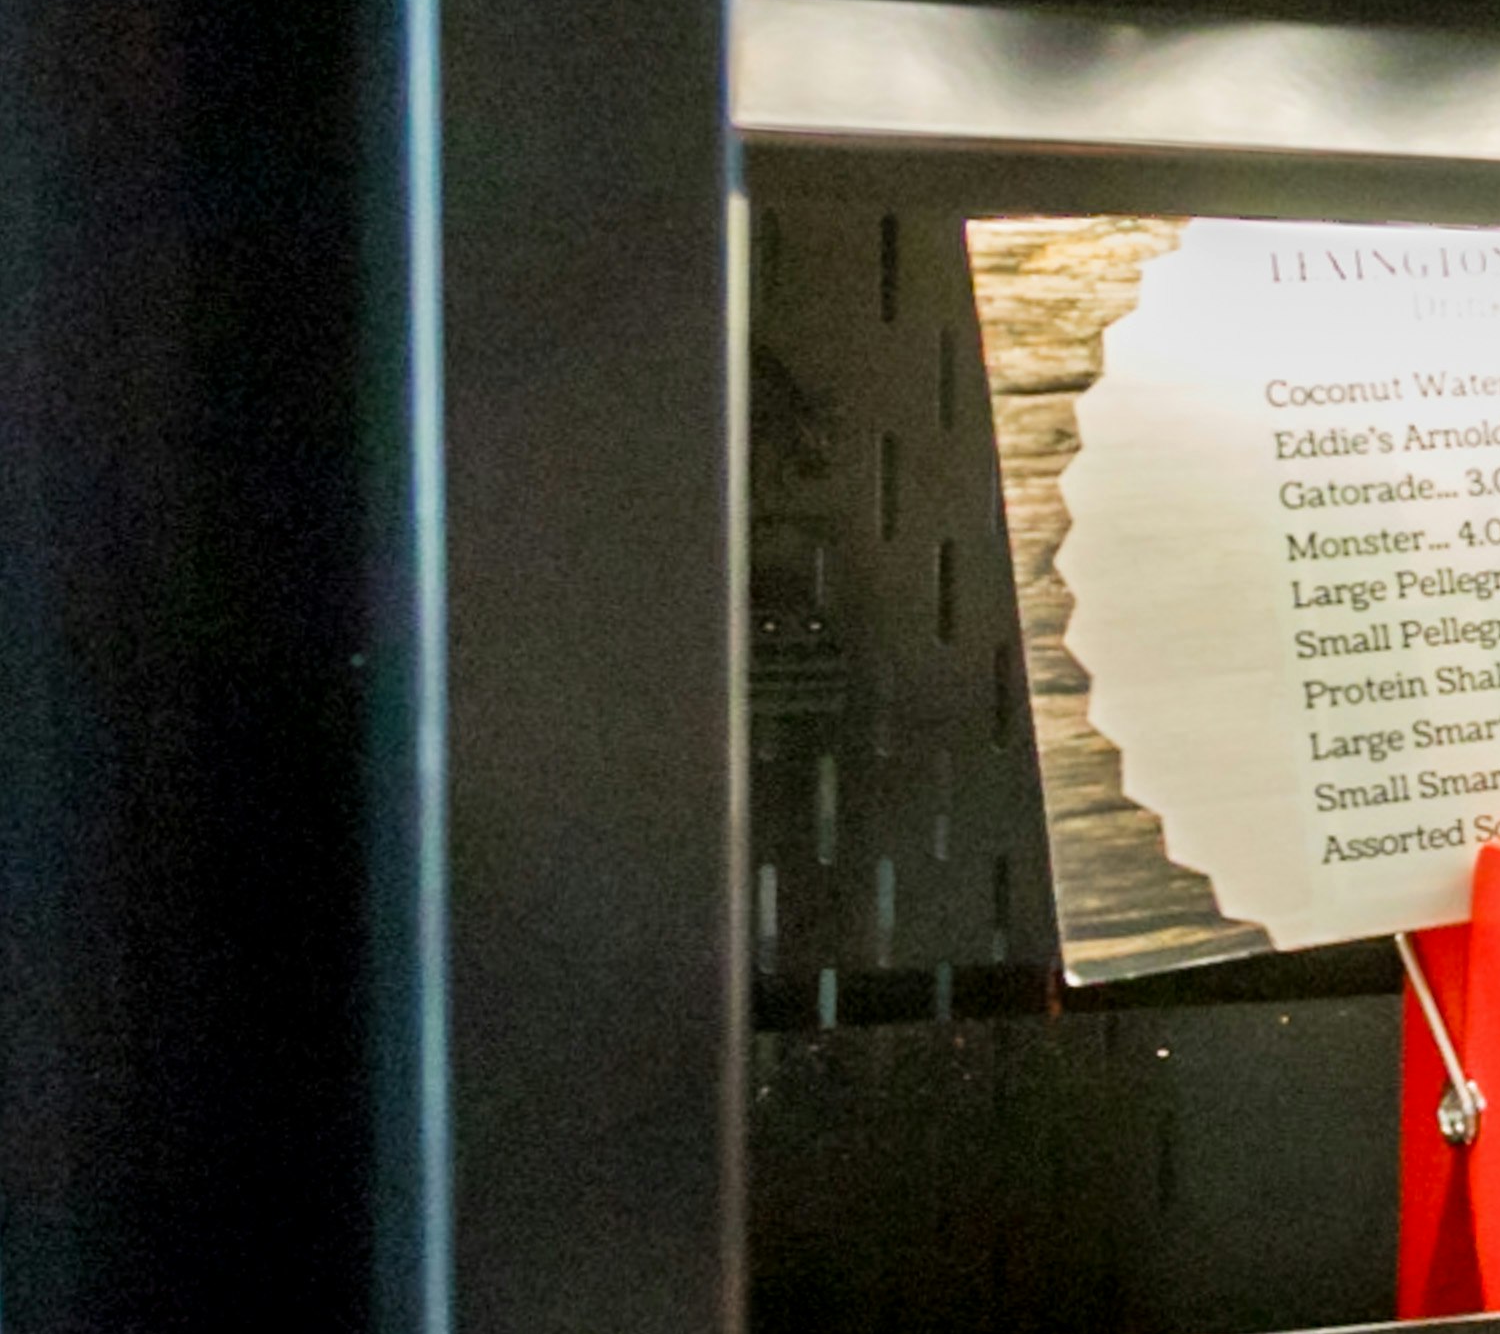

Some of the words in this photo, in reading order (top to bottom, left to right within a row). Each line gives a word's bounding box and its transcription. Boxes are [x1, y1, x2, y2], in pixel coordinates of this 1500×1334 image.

[1264, 377, 1403, 409] Coconut
[1273, 425, 1394, 461] Eddie's
[1291, 576, 1387, 612] Large
[1294, 624, 1392, 660] Small
[1303, 673, 1429, 710] Protein
[1309, 727, 1405, 763] Large
[1314, 775, 1412, 813] Small
[1321, 820, 1467, 865] Assorted
